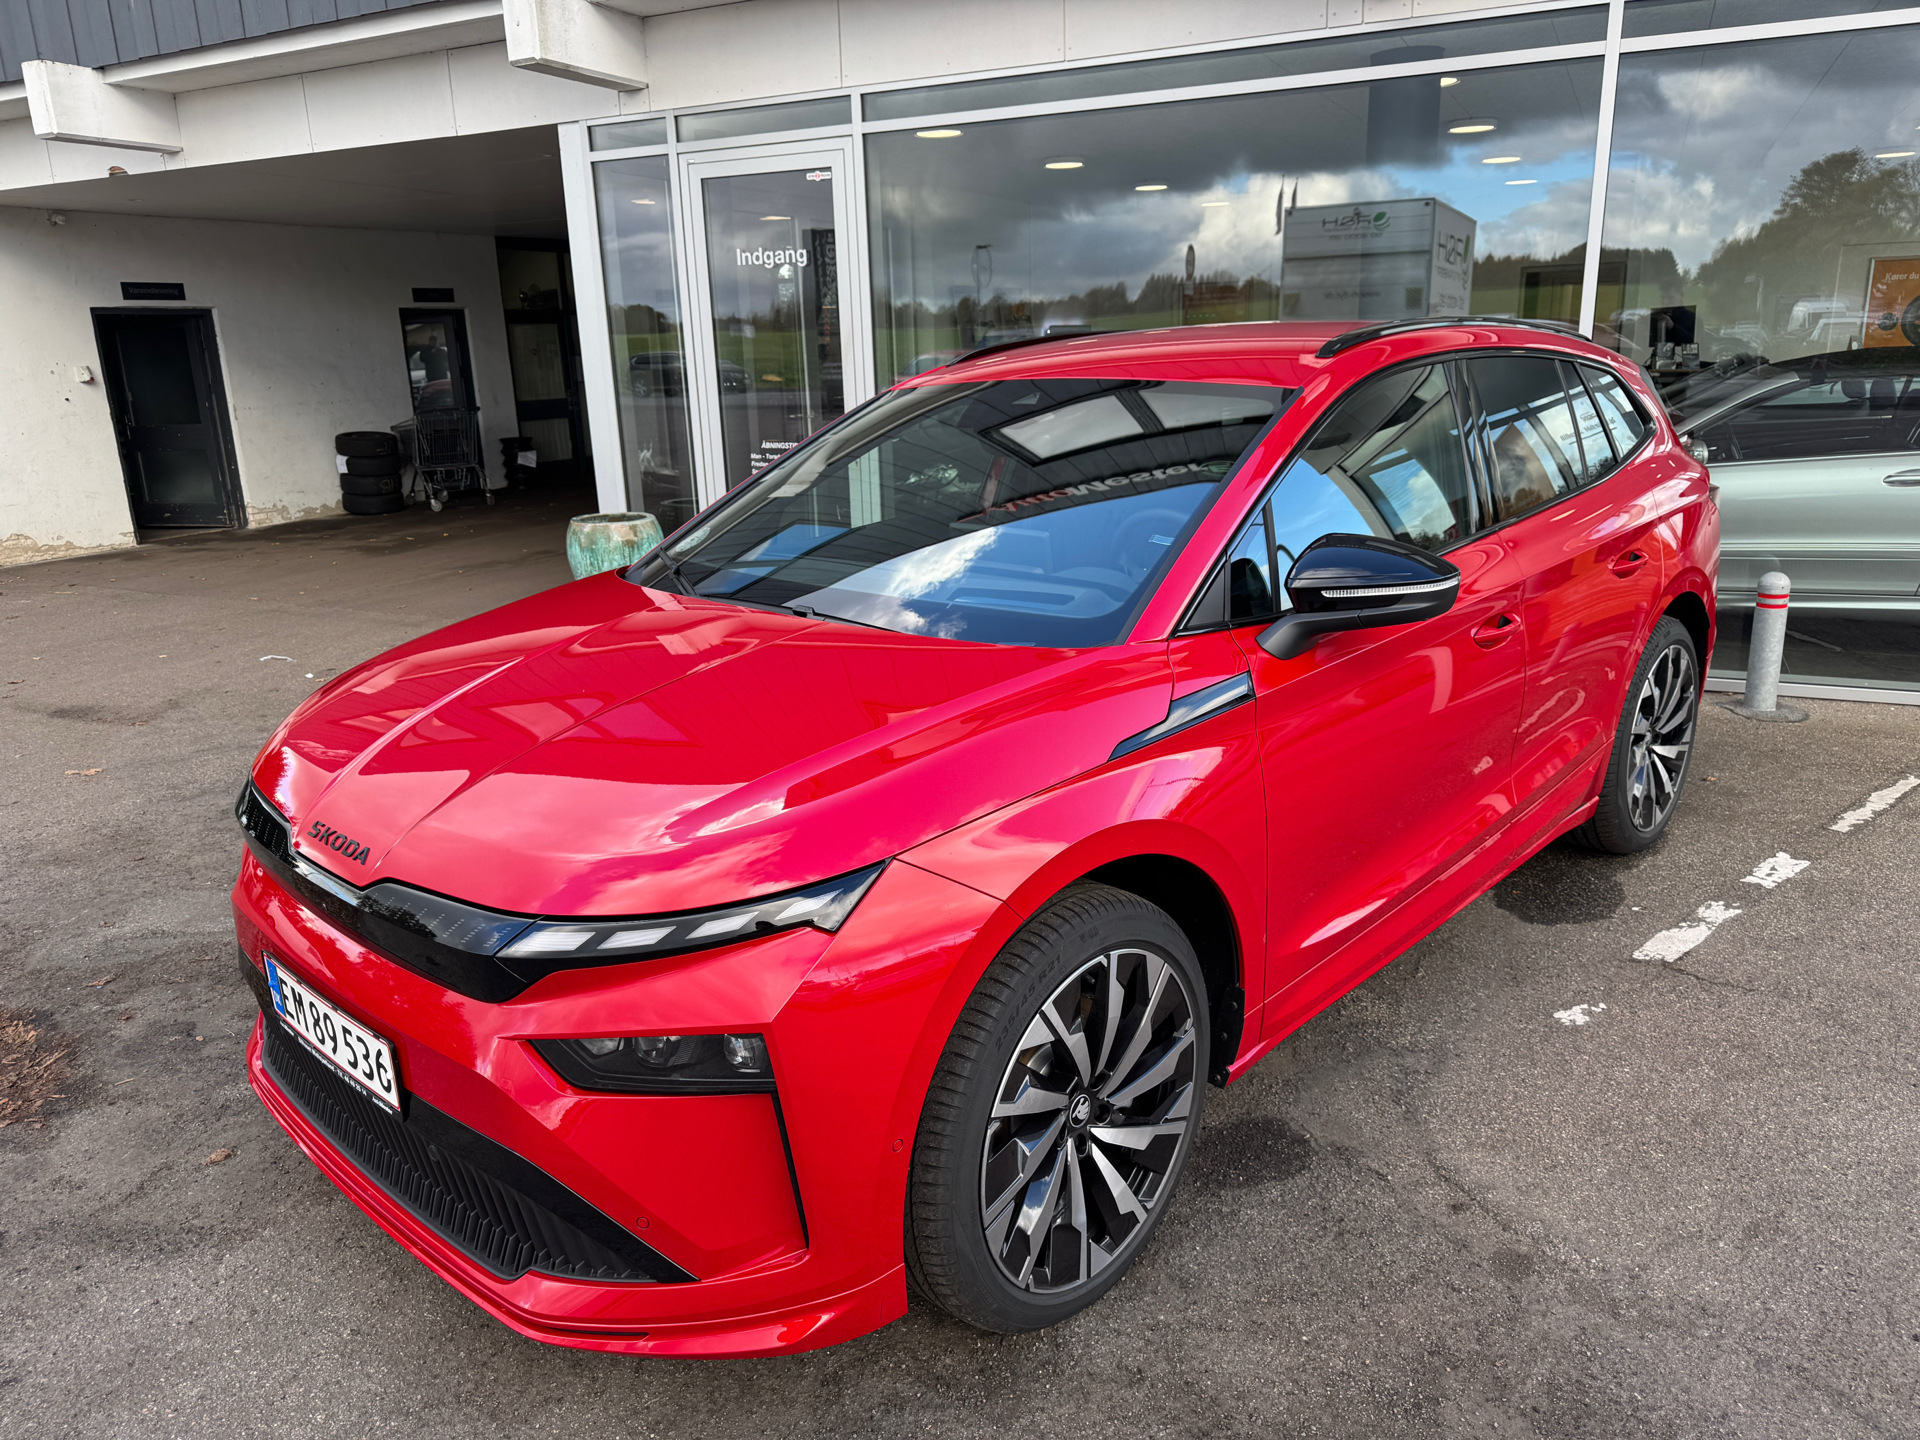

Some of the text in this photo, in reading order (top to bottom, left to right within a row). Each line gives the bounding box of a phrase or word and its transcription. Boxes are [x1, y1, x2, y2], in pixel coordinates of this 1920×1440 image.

[736, 247, 808, 269] Indgang
[1885, 271, 1920, 281] Kører du
[128, 286, 179, 296] Vareindlevering
[995, 954, 1061, 1052] 235/45 R21
[278, 975, 392, 1094] EM 89 536
